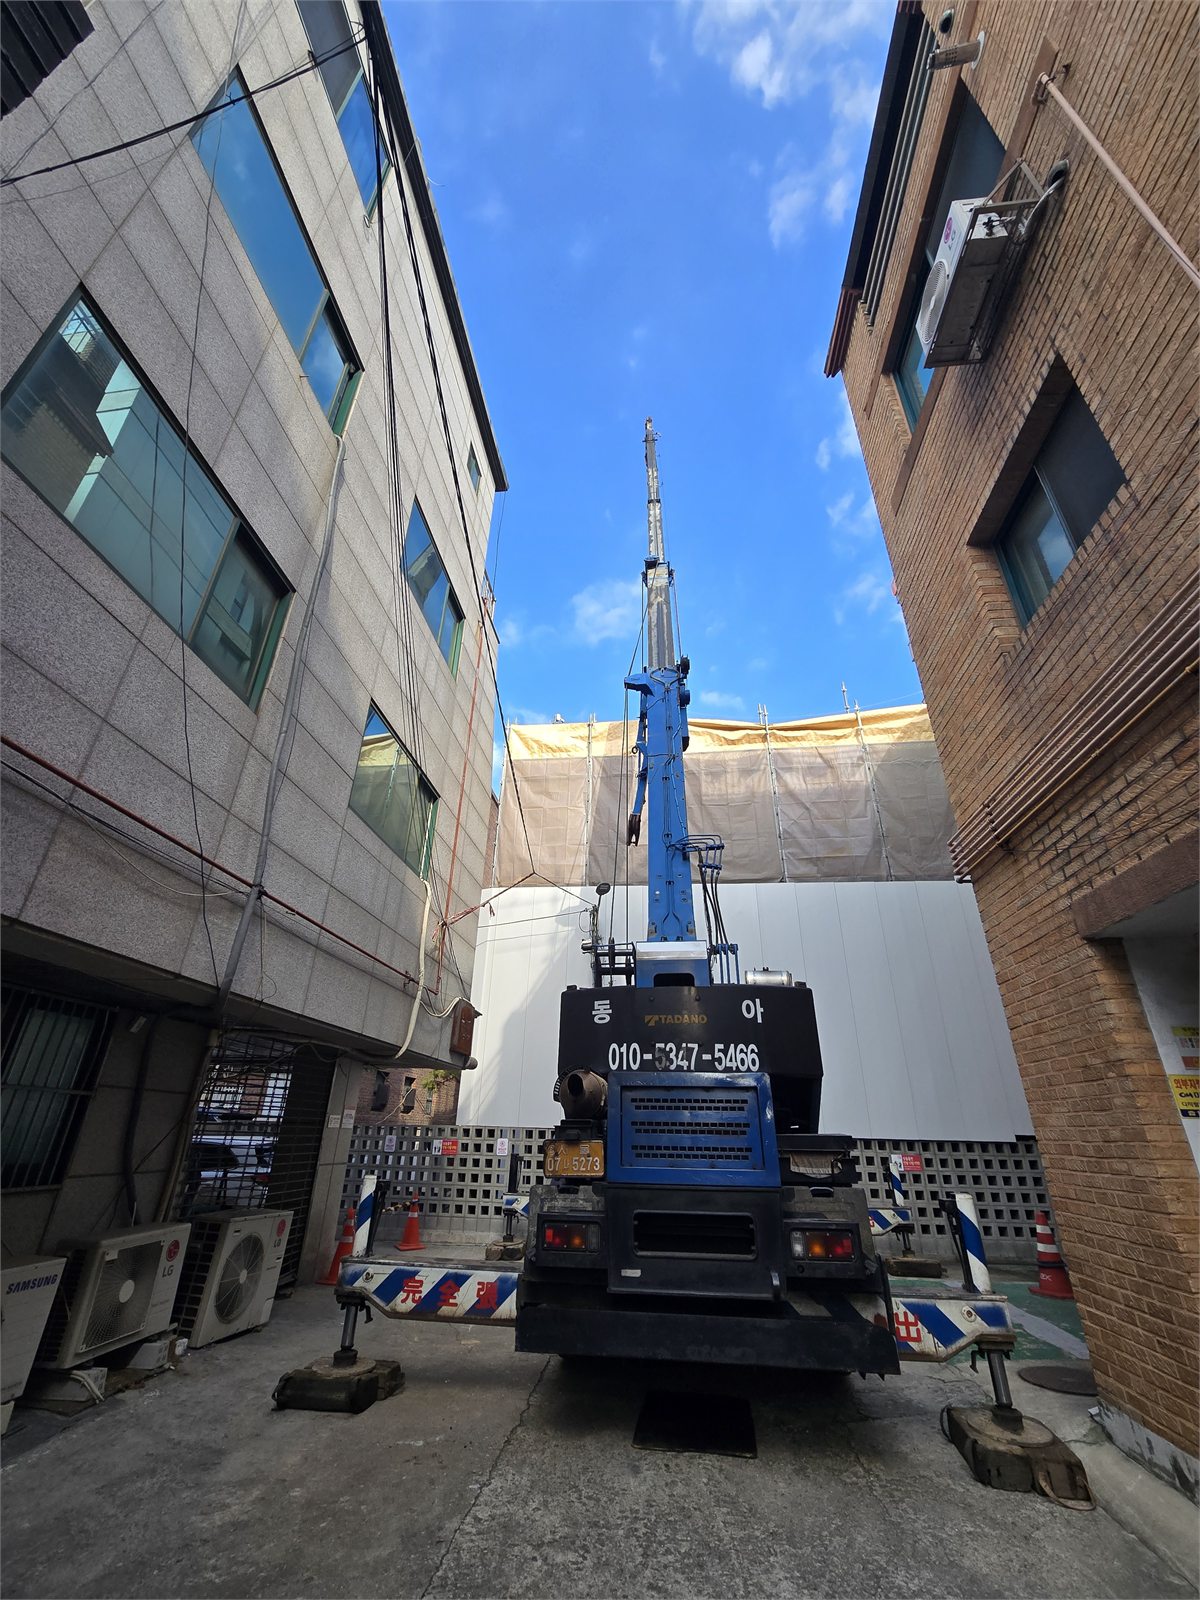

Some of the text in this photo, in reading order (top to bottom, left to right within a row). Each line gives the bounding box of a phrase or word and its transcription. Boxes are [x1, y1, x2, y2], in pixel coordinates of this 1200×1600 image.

[592, 998, 764, 1024] 동 아
[660, 1014, 707, 1025] TADANO
[608, 1042, 760, 1072] 010-5347-5466
[162, 1264, 174, 1278] LG
[6, 1274, 59, 1295] SAMSUNG
[895, 1311, 922, 1342] 出
